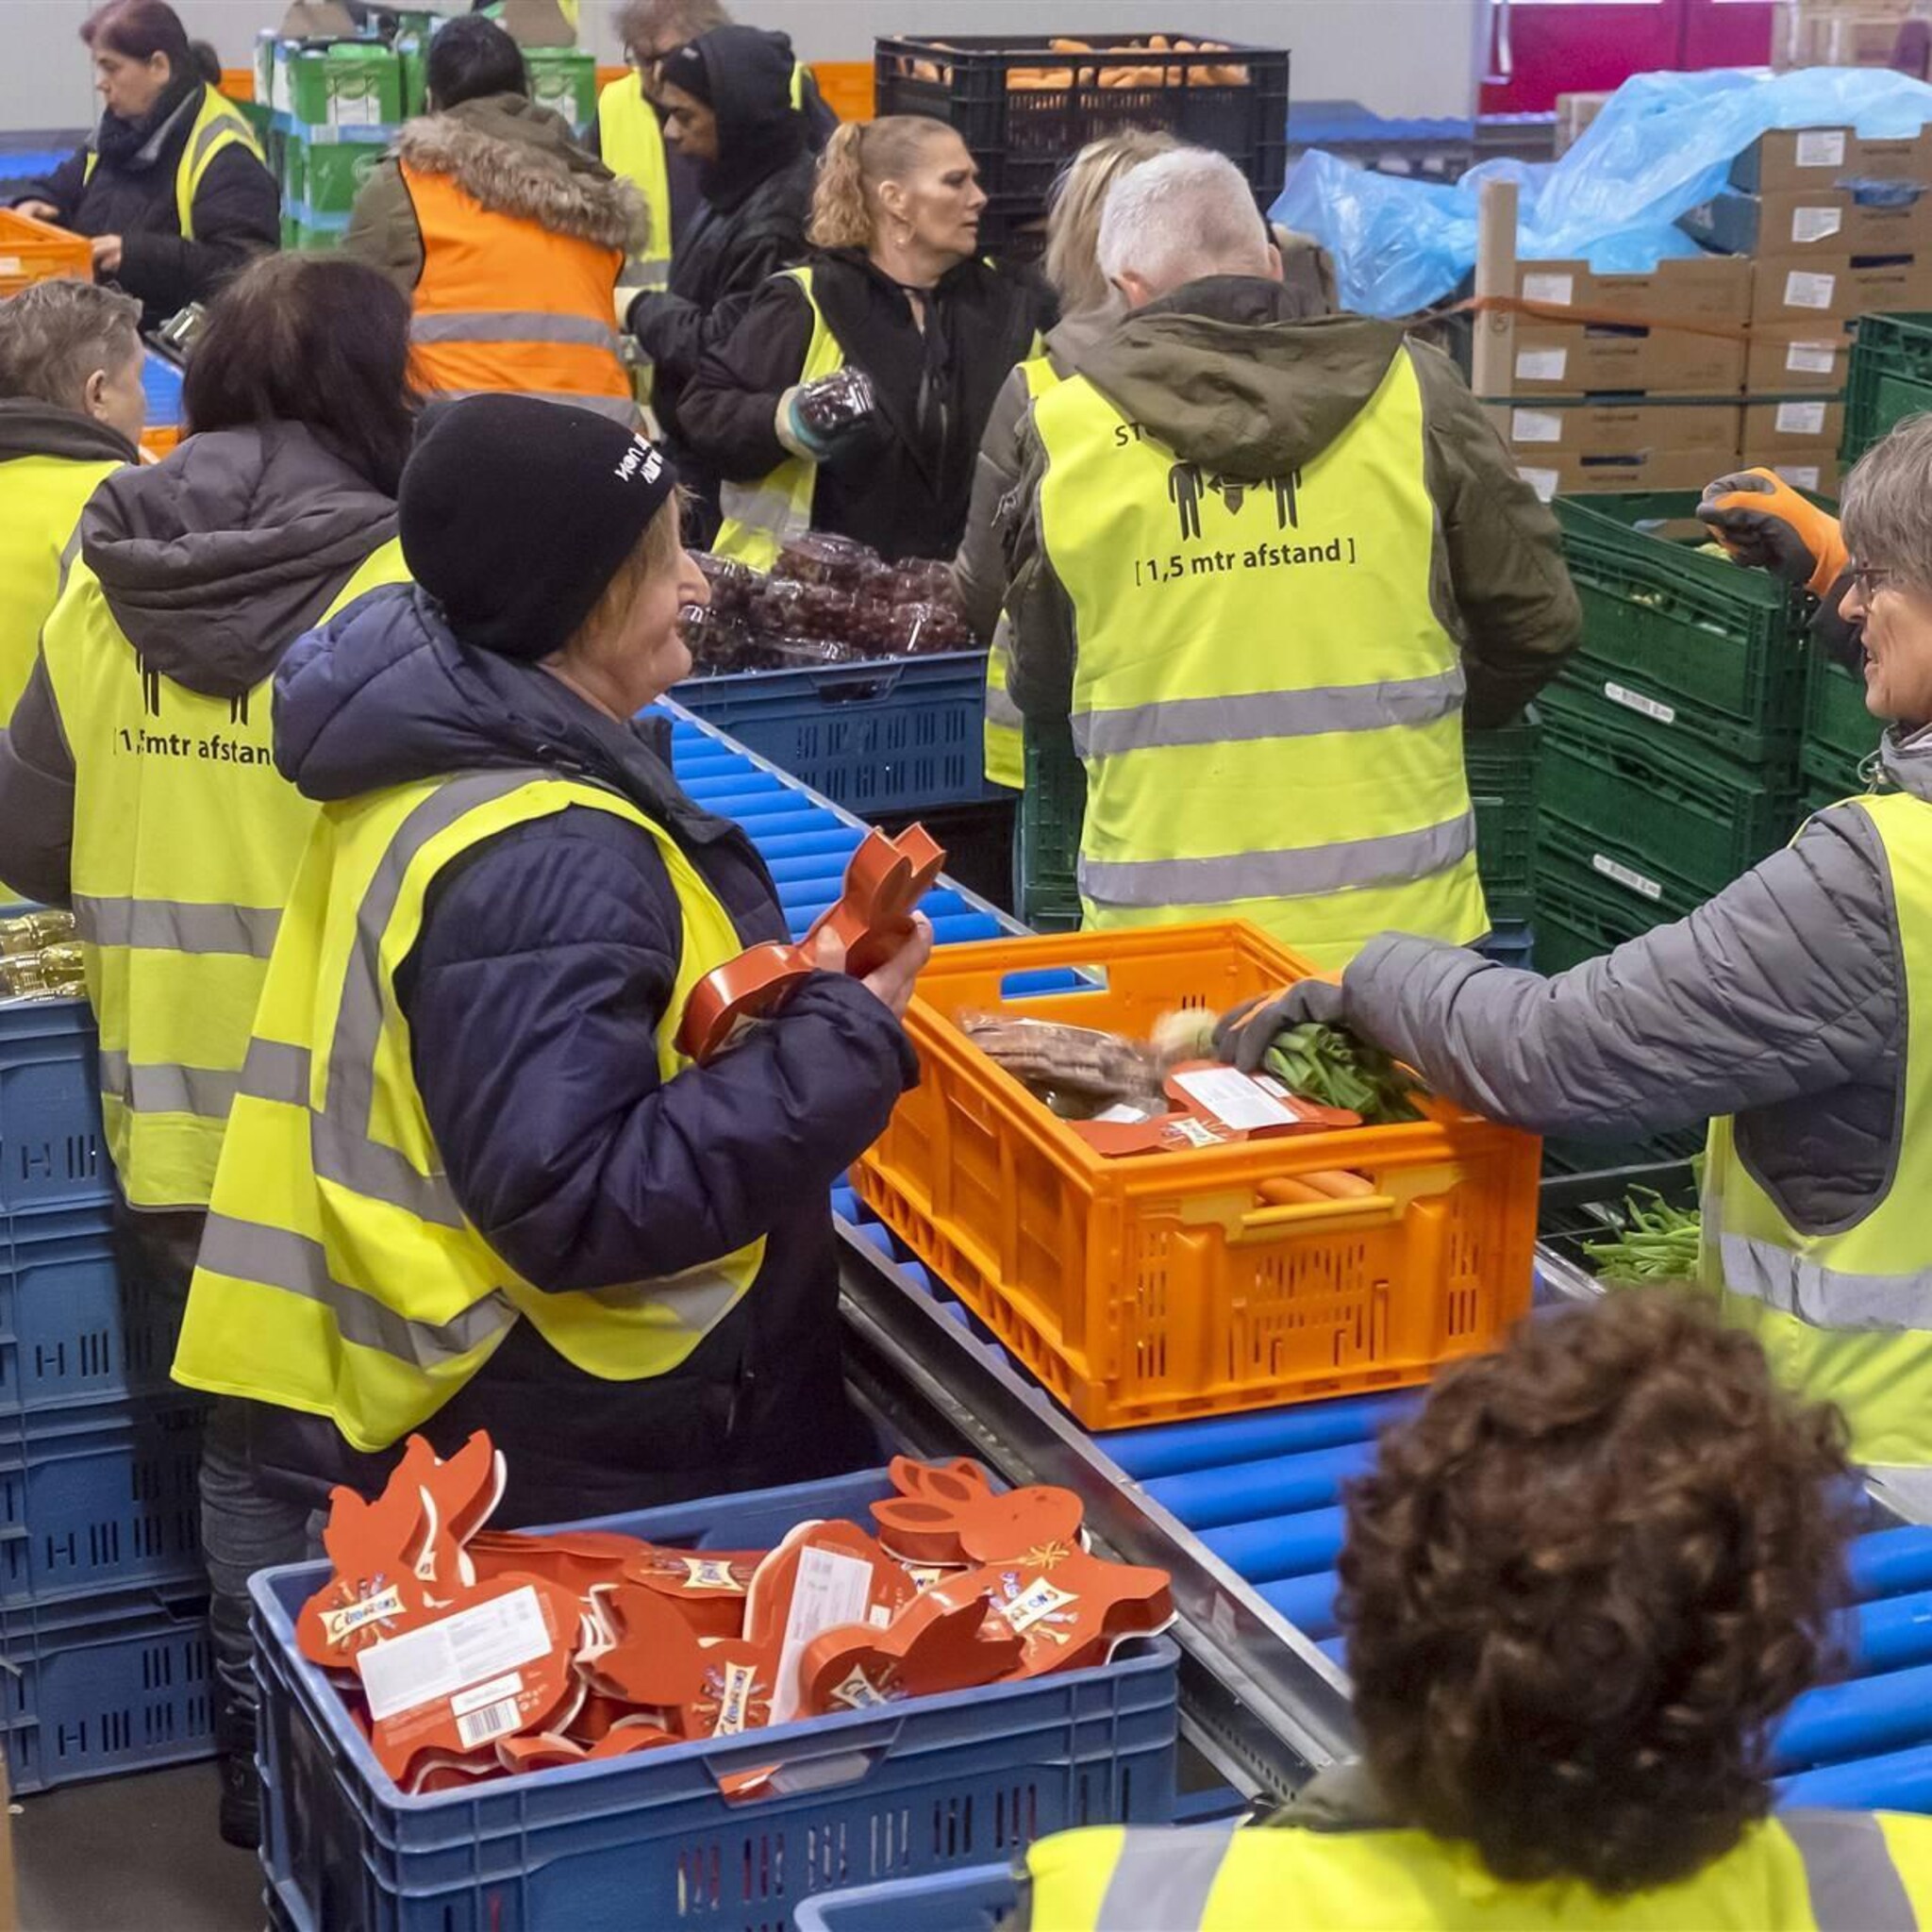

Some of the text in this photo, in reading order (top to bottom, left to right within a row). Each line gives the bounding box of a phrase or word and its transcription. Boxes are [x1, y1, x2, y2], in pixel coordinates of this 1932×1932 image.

[1191, 550, 1236, 575] mtr
[1243, 538, 1341, 568] afstand
[146, 734, 192, 757] mtr
[198, 734, 272, 766] afstan
